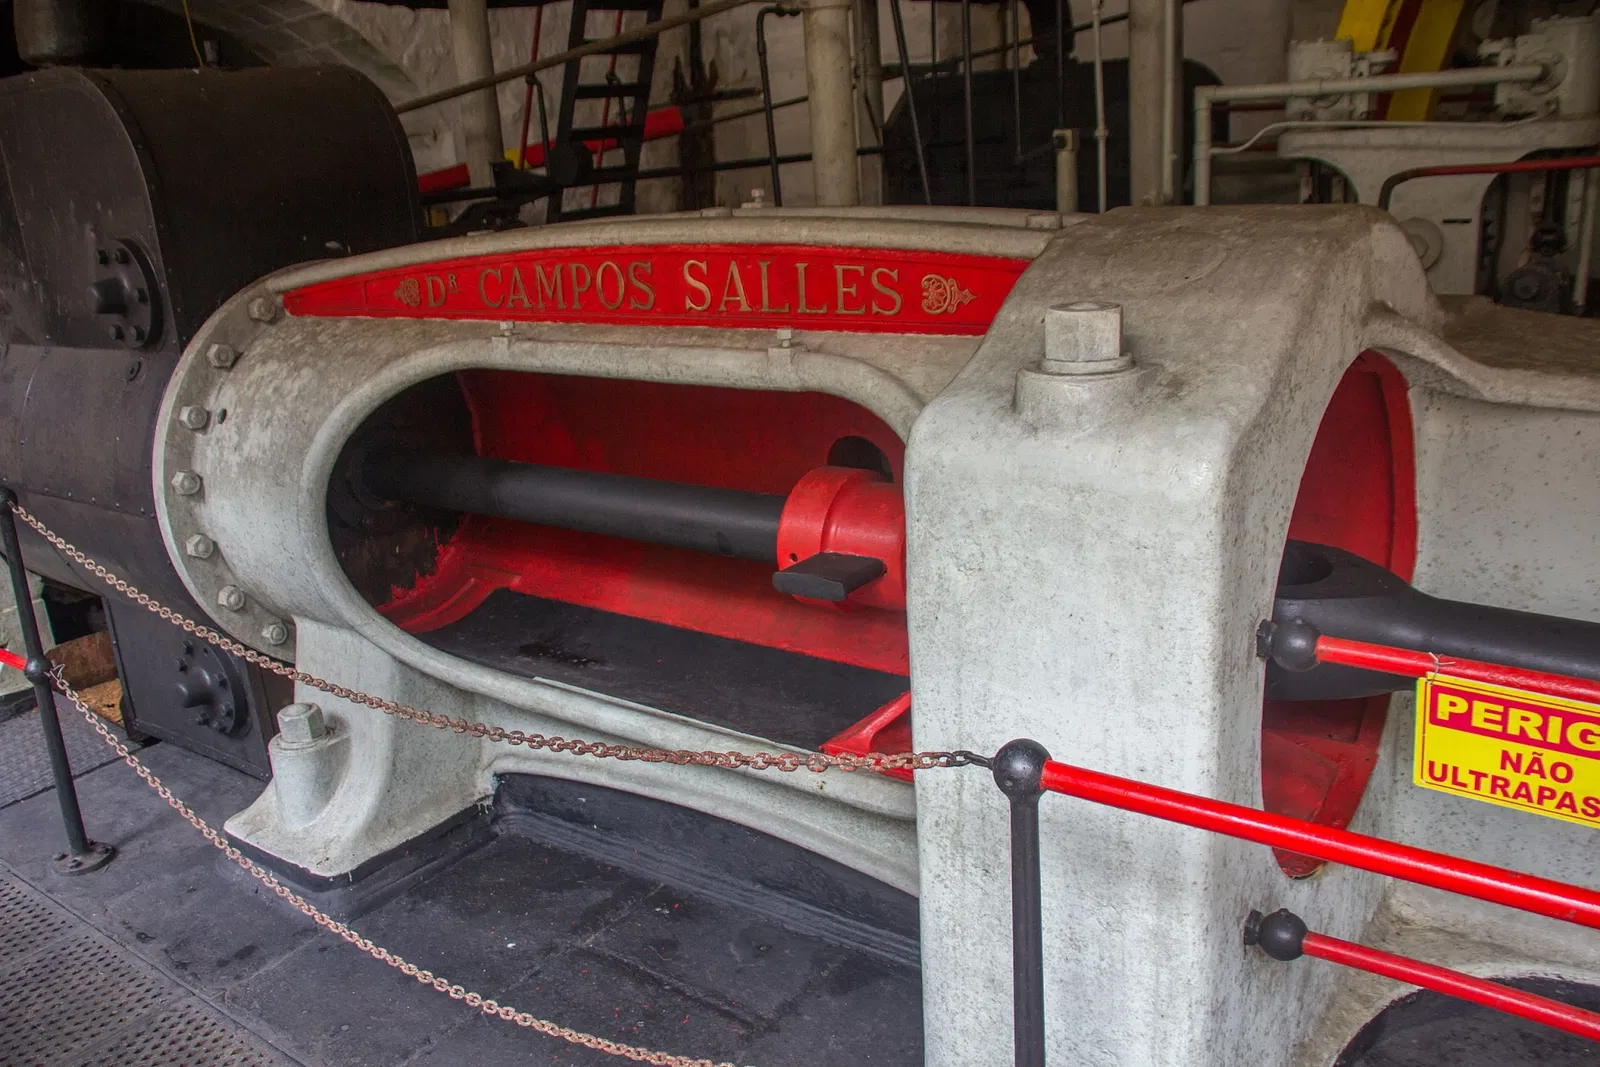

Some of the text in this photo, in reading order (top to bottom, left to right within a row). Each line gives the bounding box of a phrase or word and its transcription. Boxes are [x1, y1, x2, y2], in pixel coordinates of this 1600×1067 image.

[478, 261, 655, 311] CAMPOS
[683, 259, 902, 316] SALLES
[1436, 692, 1600, 752] PERIG
[1428, 760, 1600, 818] ULTRAPAS
[1500, 749, 1574, 784] NÃO
